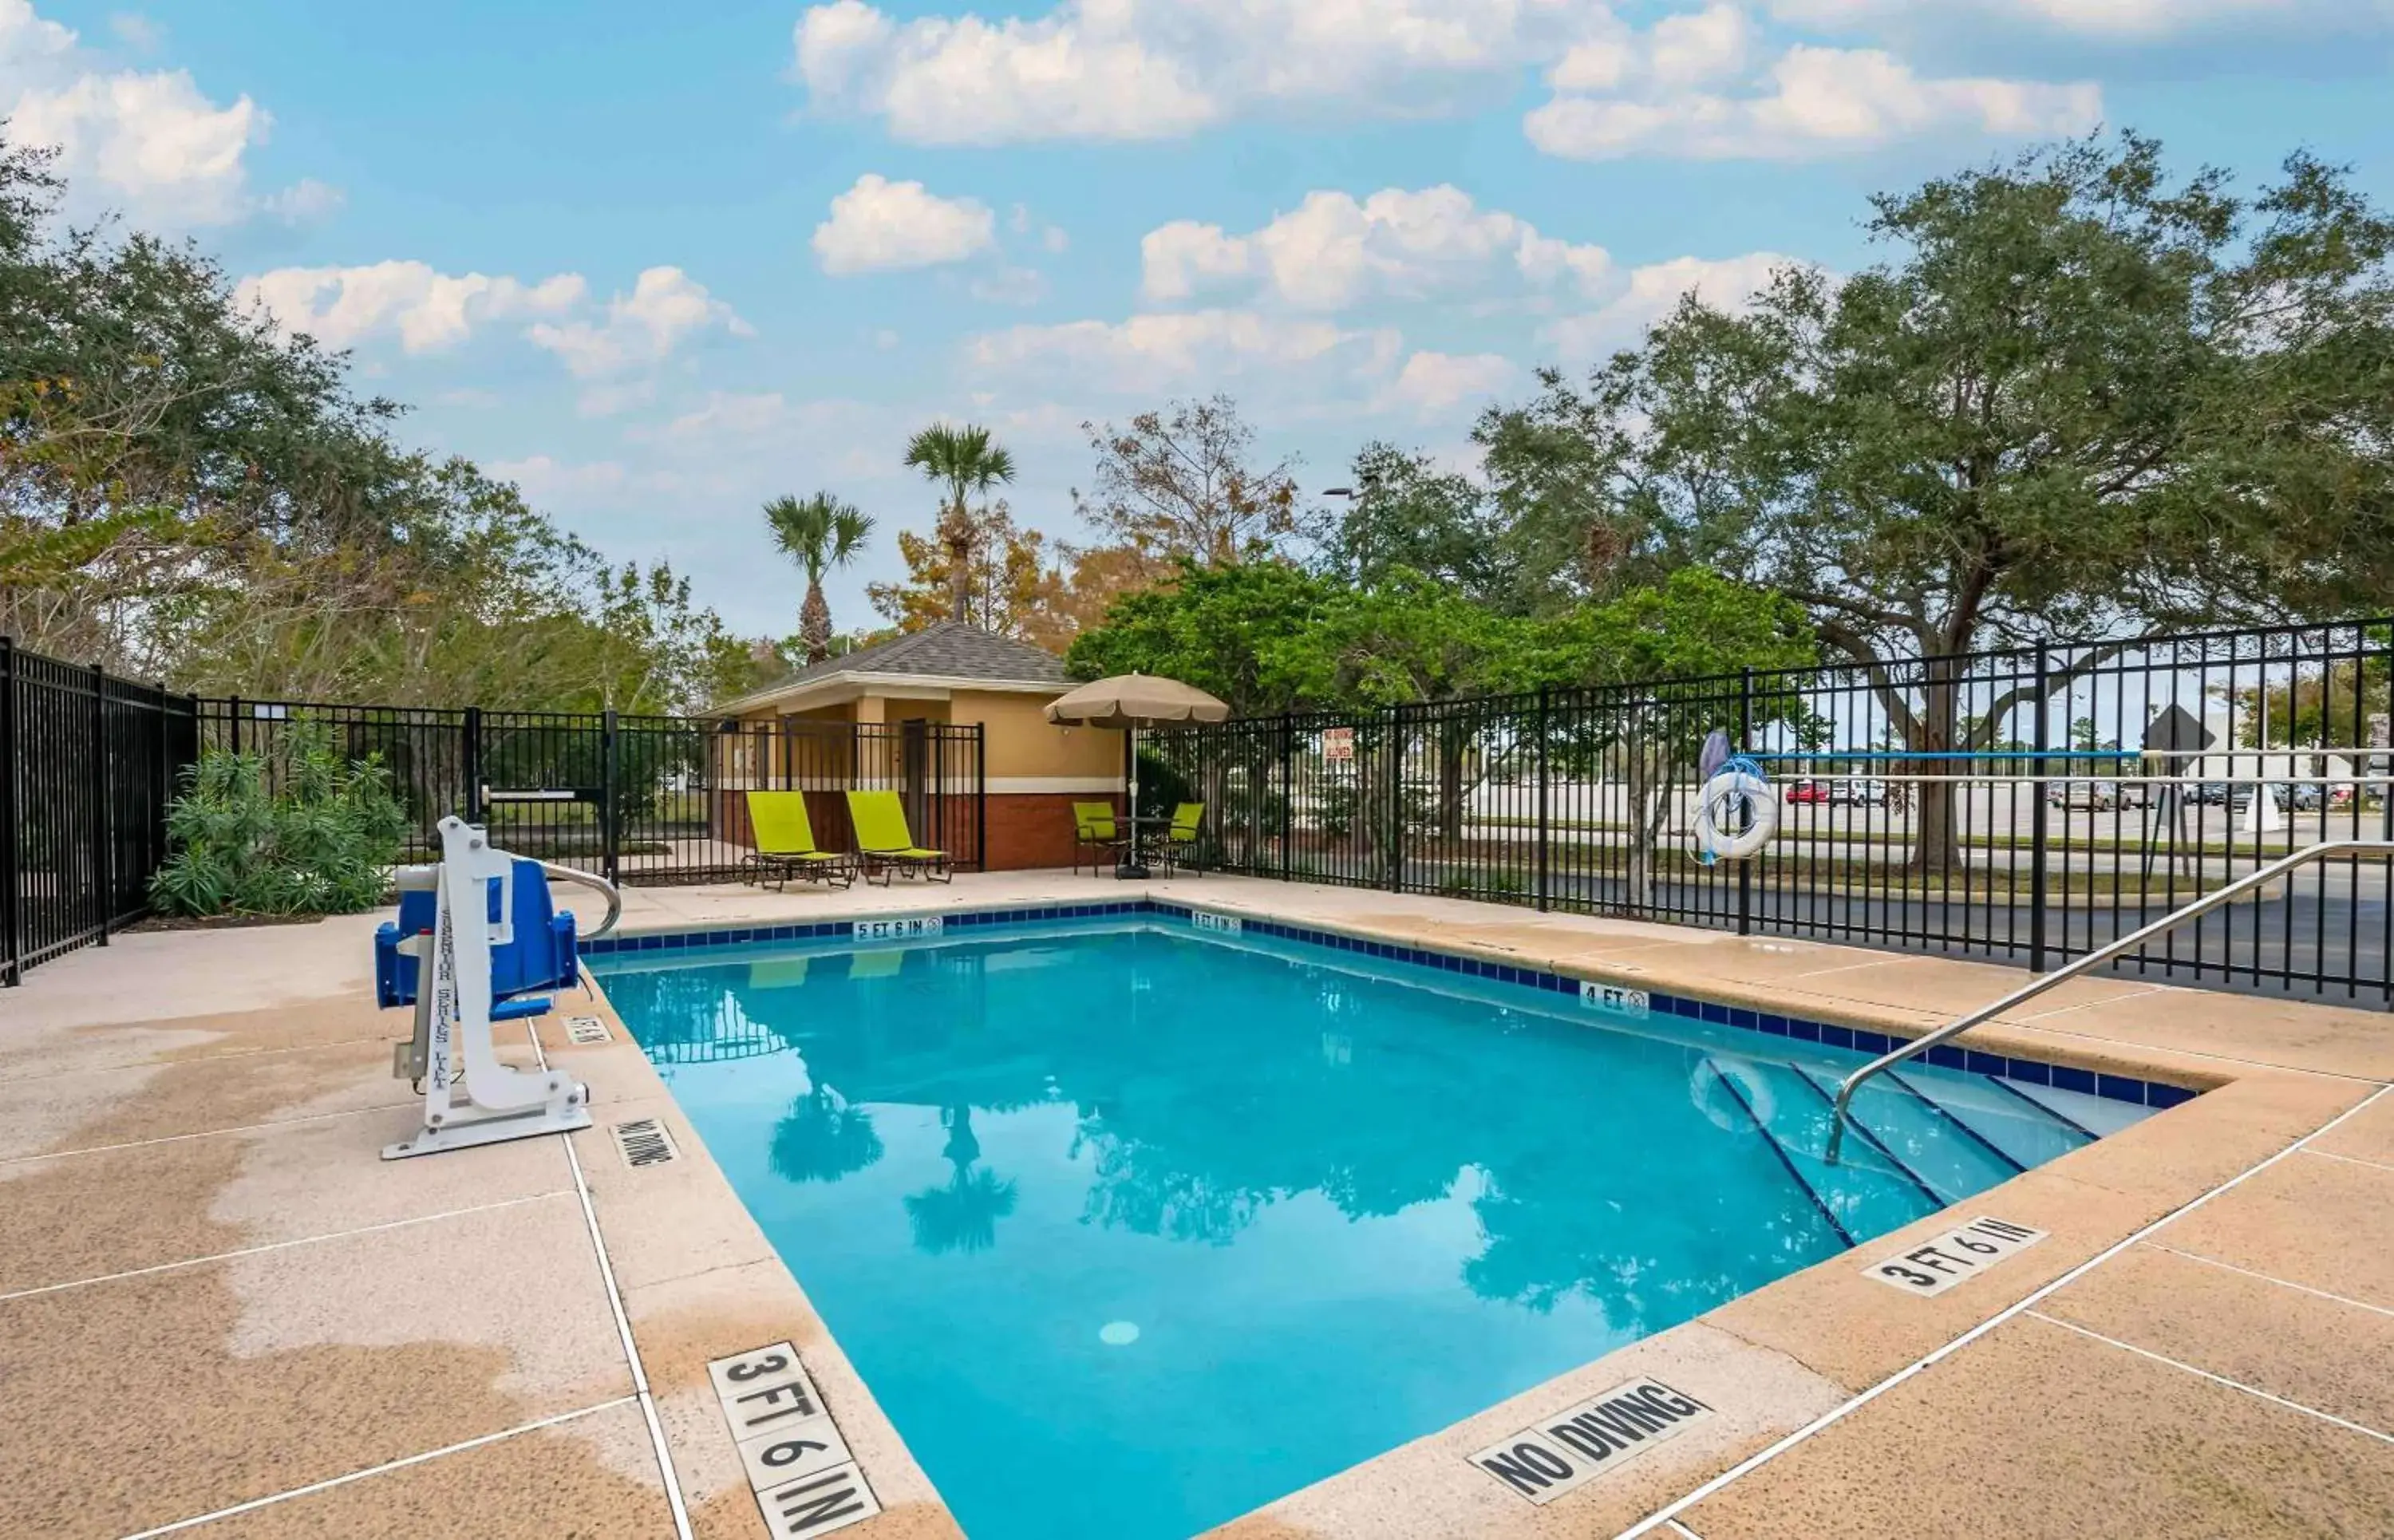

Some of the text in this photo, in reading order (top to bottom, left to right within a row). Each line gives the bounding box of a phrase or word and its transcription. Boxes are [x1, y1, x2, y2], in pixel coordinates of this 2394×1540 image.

[858, 924, 867, 934] 5
[873, 922, 889, 934] FT
[909, 920, 922, 934] IN
[435, 989, 451, 1043] SERIES
[1586, 986, 1623, 1004] 4 FT
[1881, 1218, 2036, 1286] 3 FT 6 IN
[727, 1356, 865, 1533] 3 FT 6 IN
[1483, 1384, 1701, 1496] NO DIVING
